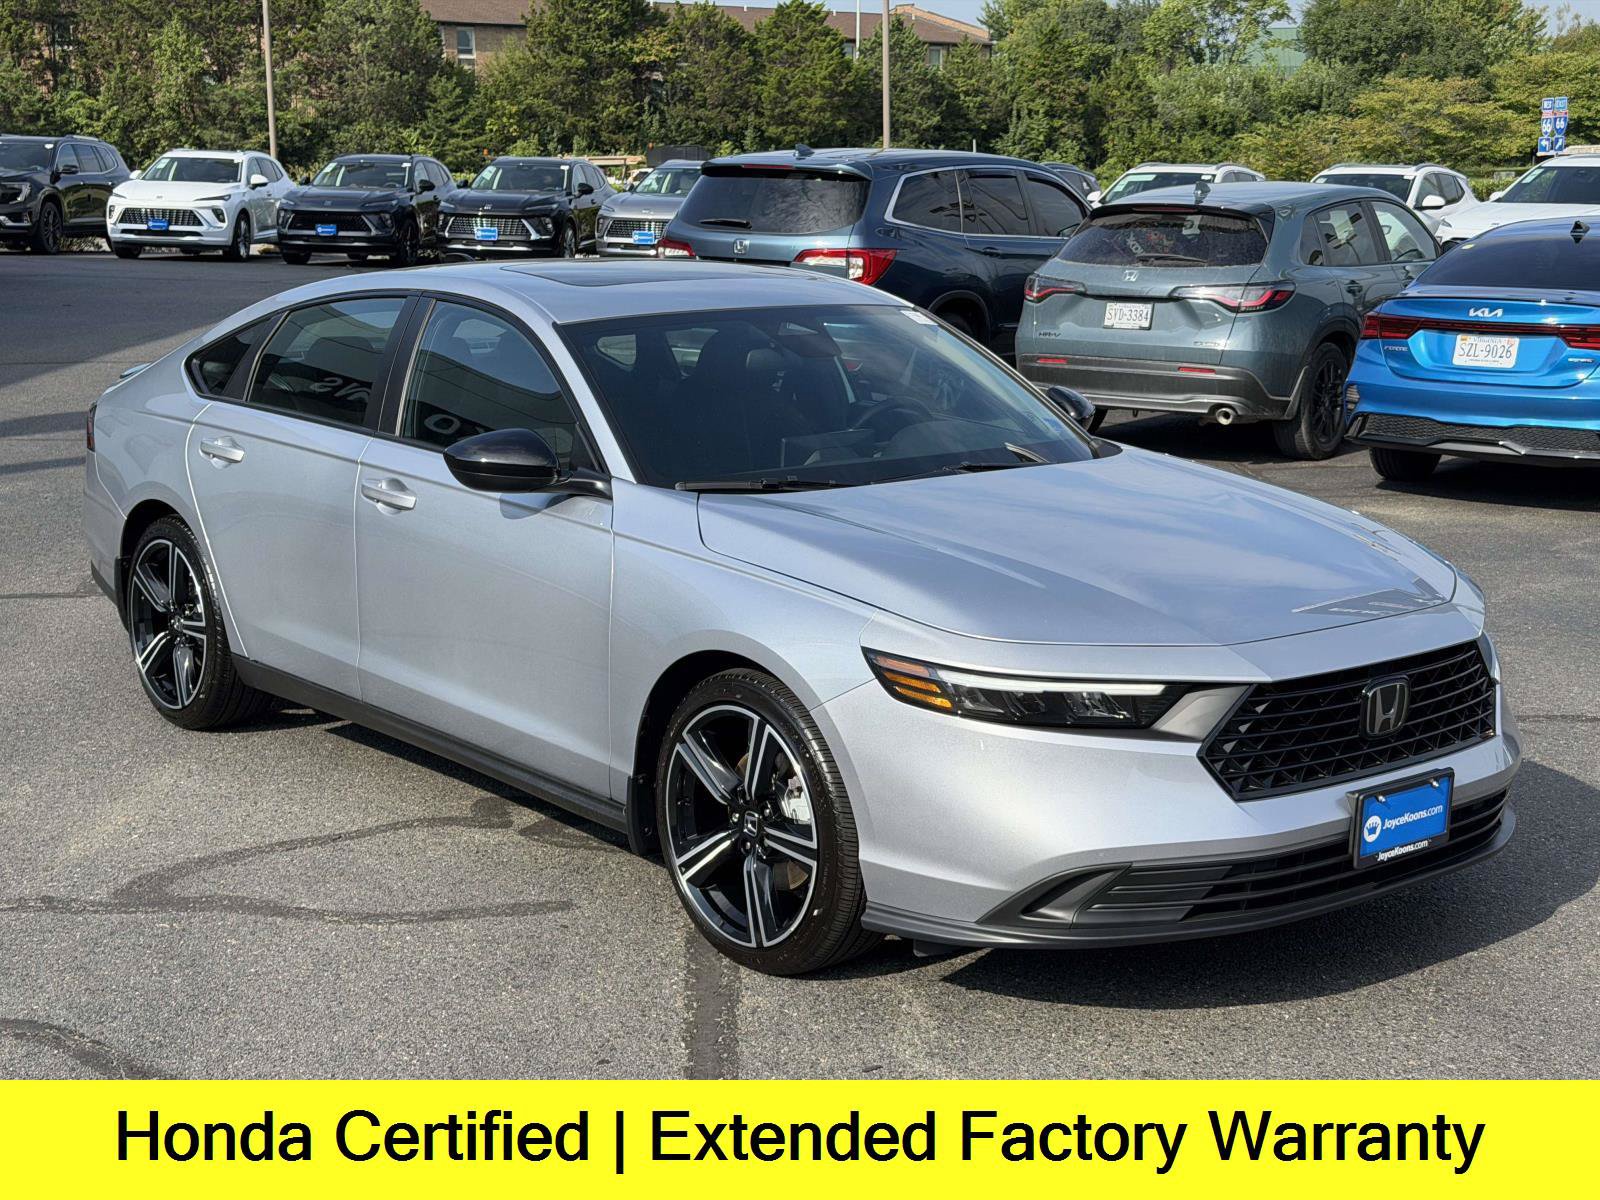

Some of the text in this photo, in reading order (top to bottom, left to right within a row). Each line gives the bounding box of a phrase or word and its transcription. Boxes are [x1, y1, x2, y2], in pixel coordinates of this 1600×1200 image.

[1542, 118, 1552, 132] 66
[1556, 118, 1565, 129] 66
[1469, 307, 1503, 318] KIA
[1458, 342, 1514, 359] SZL-9026
[1382, 804, 1443, 831] JoyceKoons.com
[1377, 840, 1429, 862] JoyceKoons.com
